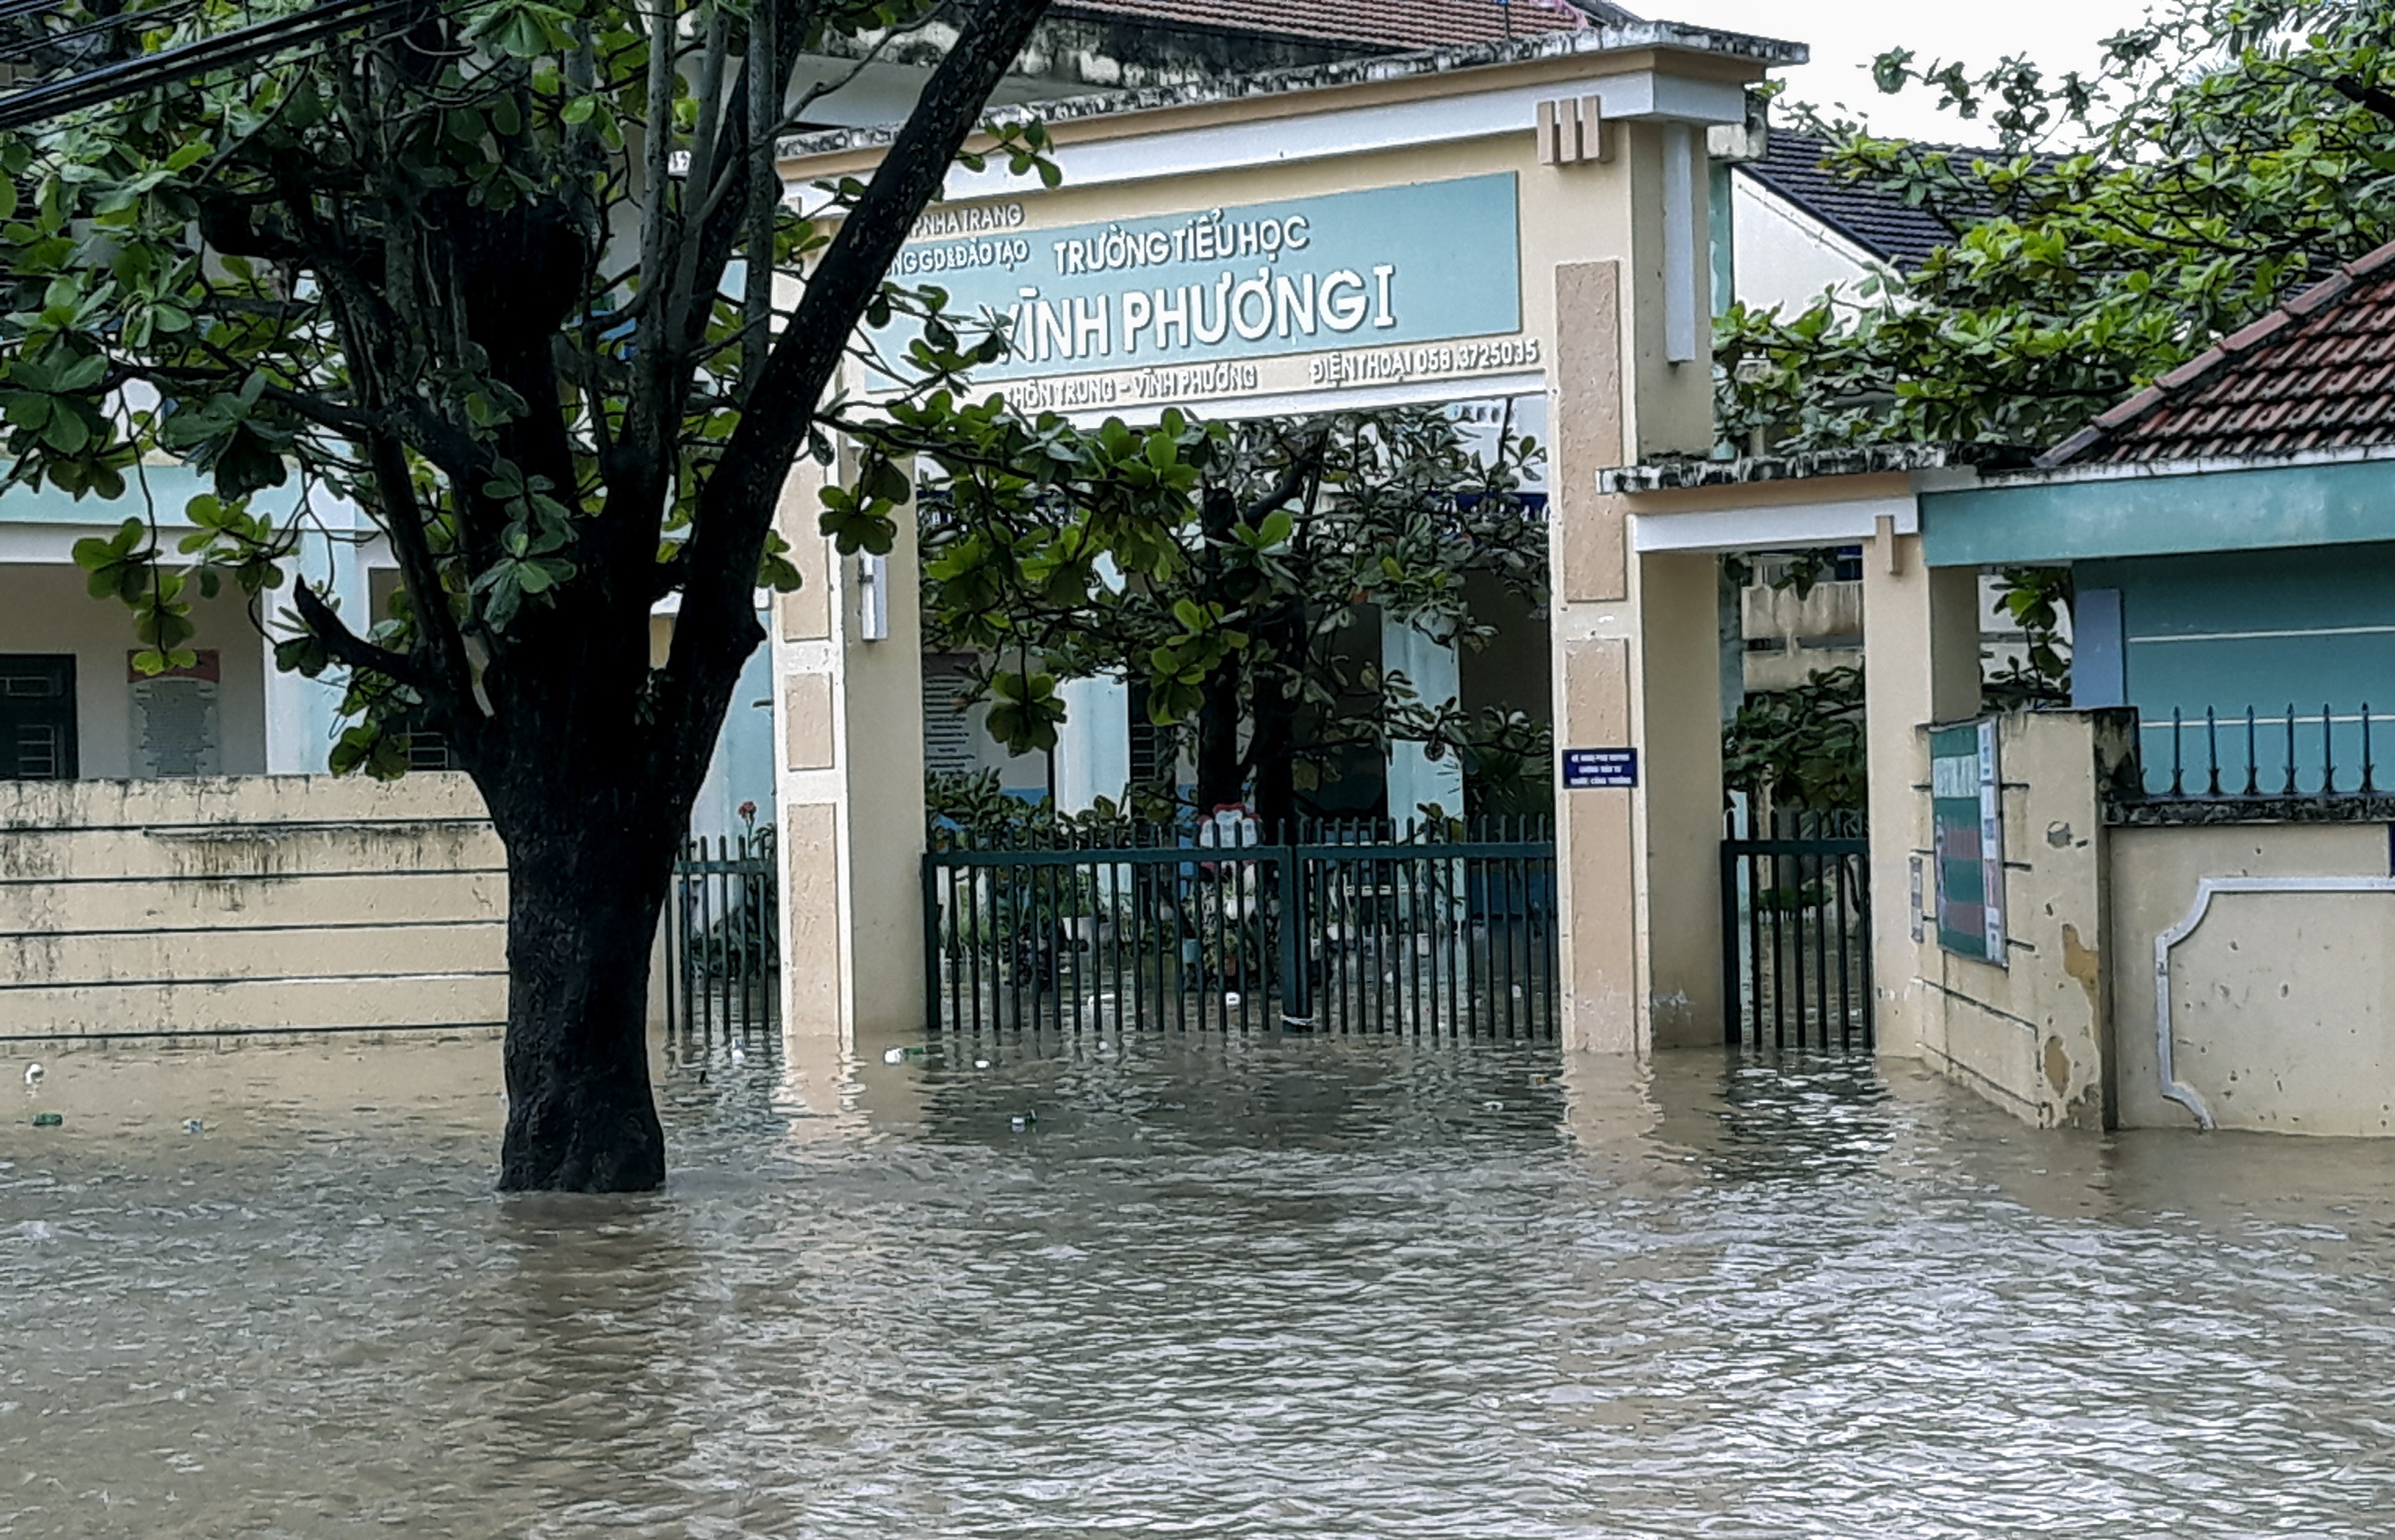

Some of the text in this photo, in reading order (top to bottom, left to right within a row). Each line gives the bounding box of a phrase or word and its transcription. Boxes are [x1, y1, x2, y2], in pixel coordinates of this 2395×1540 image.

[962, 203, 1025, 231] TRANG
[994, 239, 1030, 270] TẠO
[1054, 208, 1310, 274] TRƯỜNG TIỂU HỌC
[986, 264, 1398, 365] VĨNH PHƯƠNG I
[1054, 378, 1116, 406] TRUNG
[1134, 367, 1178, 398] VĨNH
[1309, 351, 1357, 388] ĐIỆN
[1355, 350, 1414, 382] THOẠI
